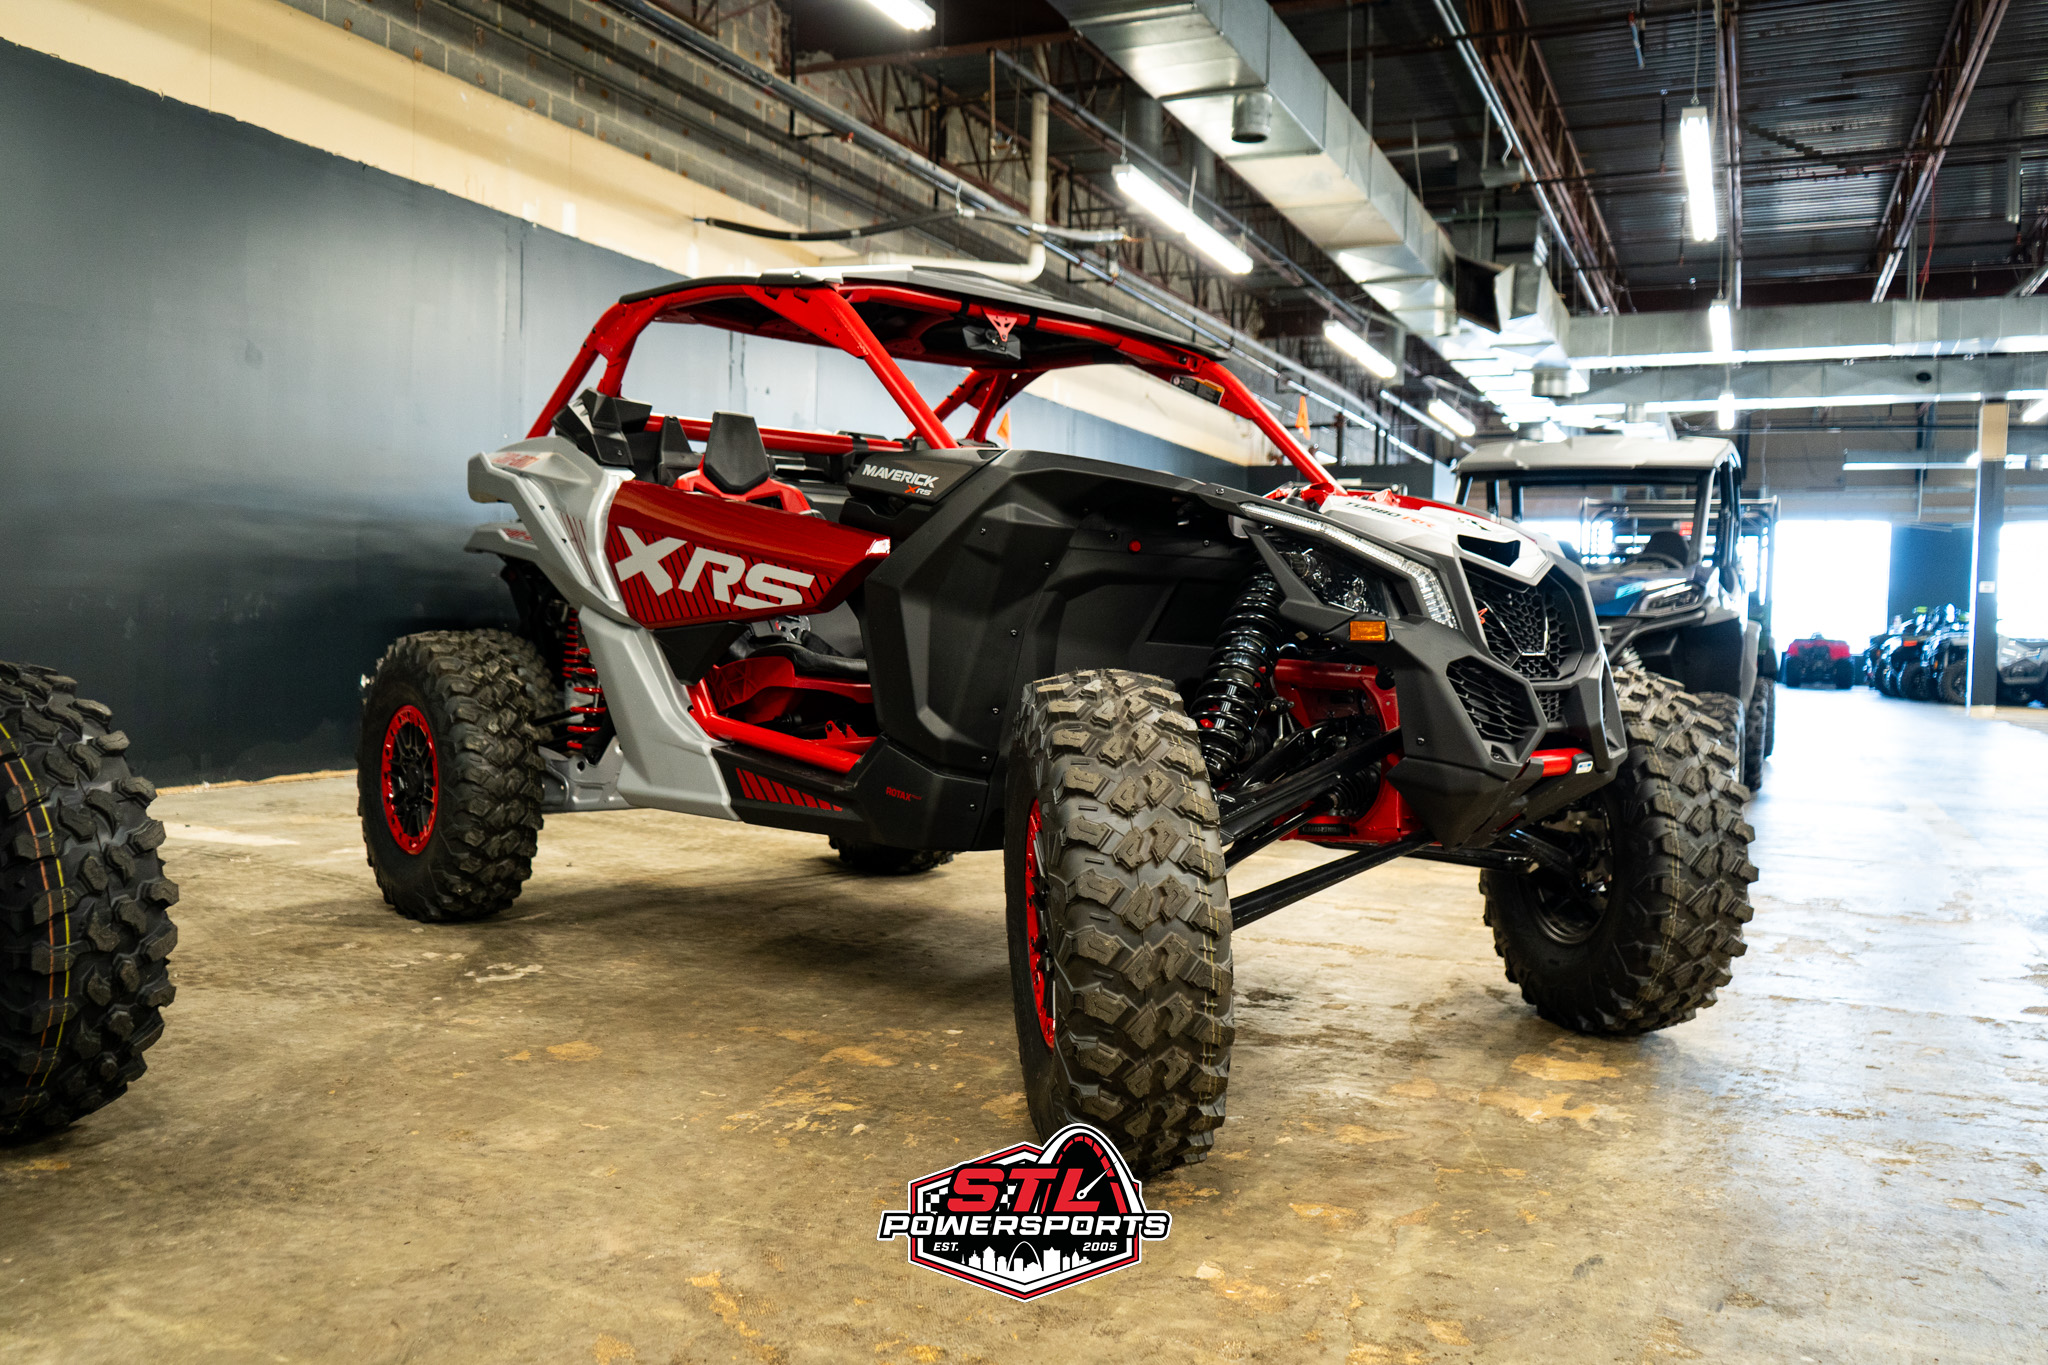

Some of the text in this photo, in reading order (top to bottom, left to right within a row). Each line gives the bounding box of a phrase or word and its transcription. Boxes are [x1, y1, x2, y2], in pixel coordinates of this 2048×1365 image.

[862, 464, 939, 488] MAVERICK
[904, 484, 933, 496] XRS
[614, 525, 816, 610] XRS
[886, 786, 912, 802] ROTAX
